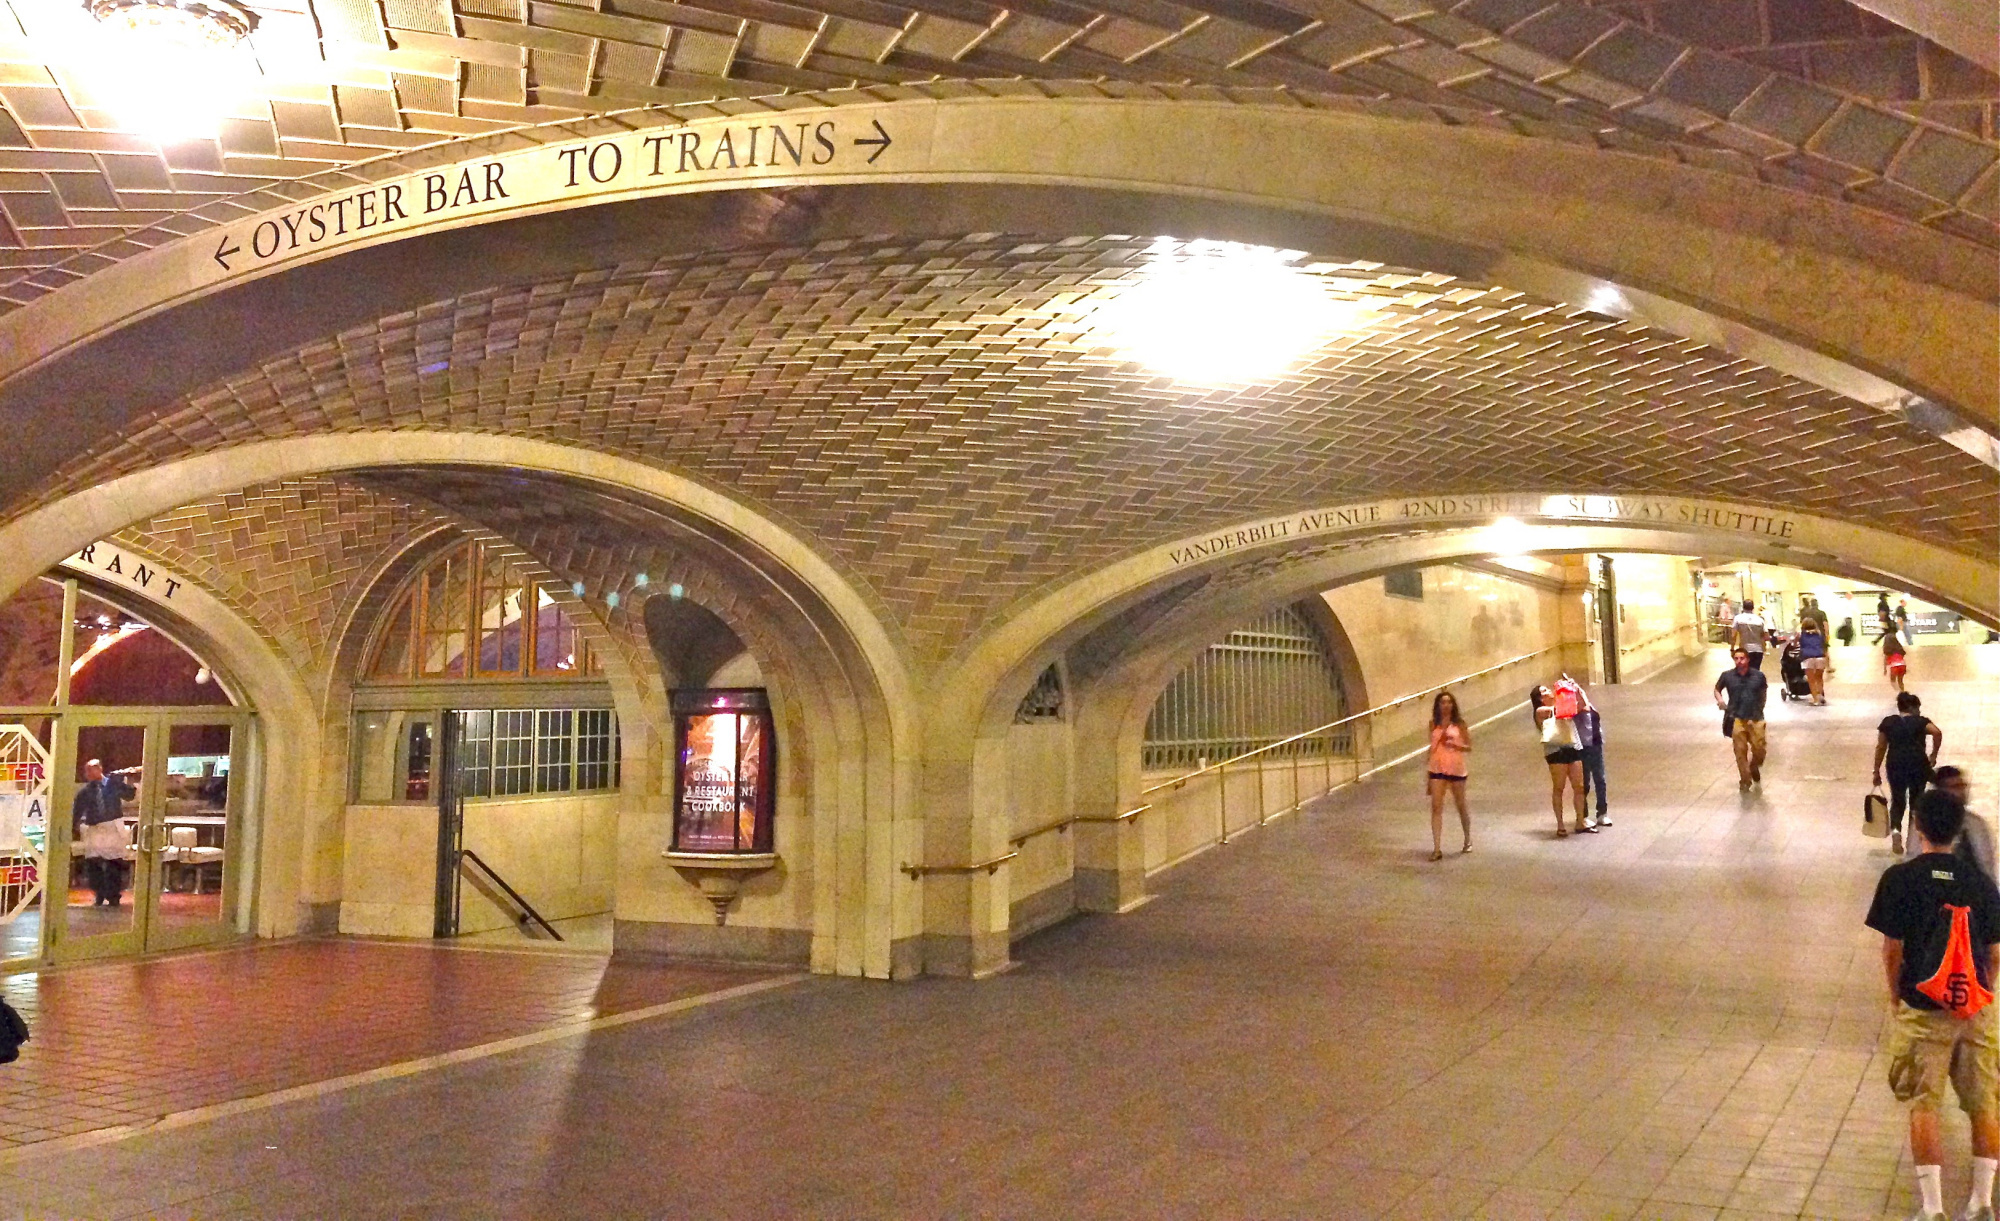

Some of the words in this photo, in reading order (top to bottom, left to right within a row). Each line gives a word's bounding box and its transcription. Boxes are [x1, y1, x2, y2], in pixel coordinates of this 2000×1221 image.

[558, 142, 622, 188] TO
[642, 121, 835, 176] TRAINS
[252, 184, 408, 259] OYSTER
[423, 162, 510, 214] BAR
[1169, 518, 1290, 566] VANDERBILT
[1298, 506, 1381, 532] AVENUE
[1400, 499, 1457, 517] 42ND
[1678, 504, 1794, 539] SHUTTLE
[28, 799, 42, 818] A
[694, 785, 754, 797] RESTAURNT
